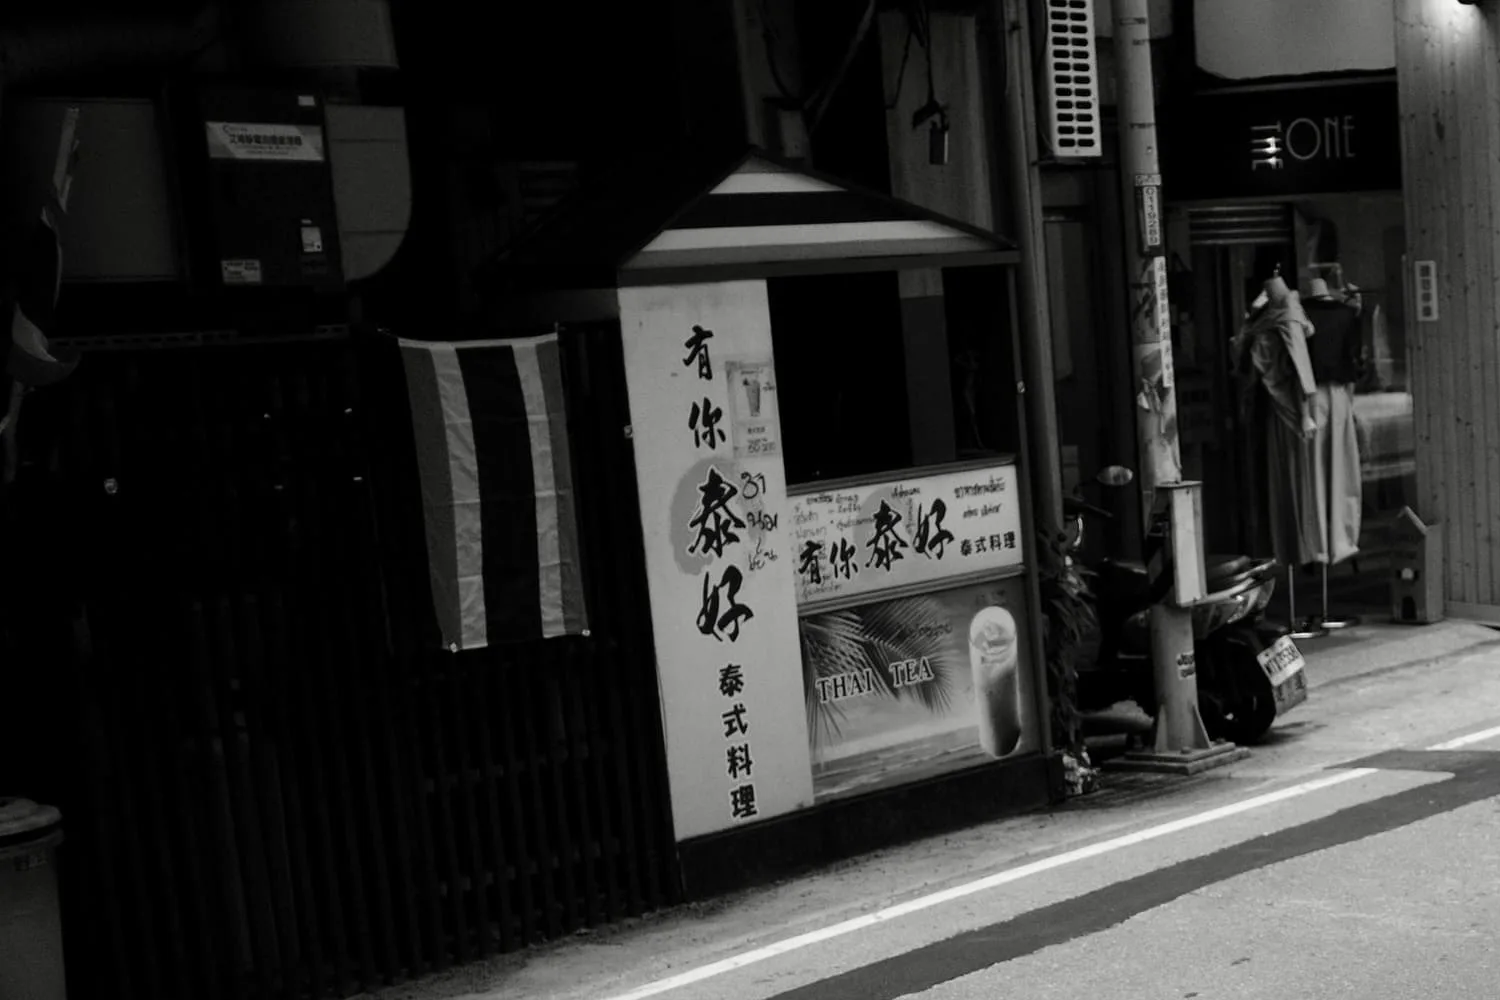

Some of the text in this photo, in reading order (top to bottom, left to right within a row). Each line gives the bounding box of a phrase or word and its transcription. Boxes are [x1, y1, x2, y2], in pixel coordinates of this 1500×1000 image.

[1249, 115, 1356, 172] THE ONE
[682, 325, 755, 643] 有你泰好
[799, 498, 955, 584] 有你泰好
[960, 530, 1017, 557] 泰式料理
[815, 656, 935, 703] THAI TEA
[717, 662, 759, 819] 泰式料理
